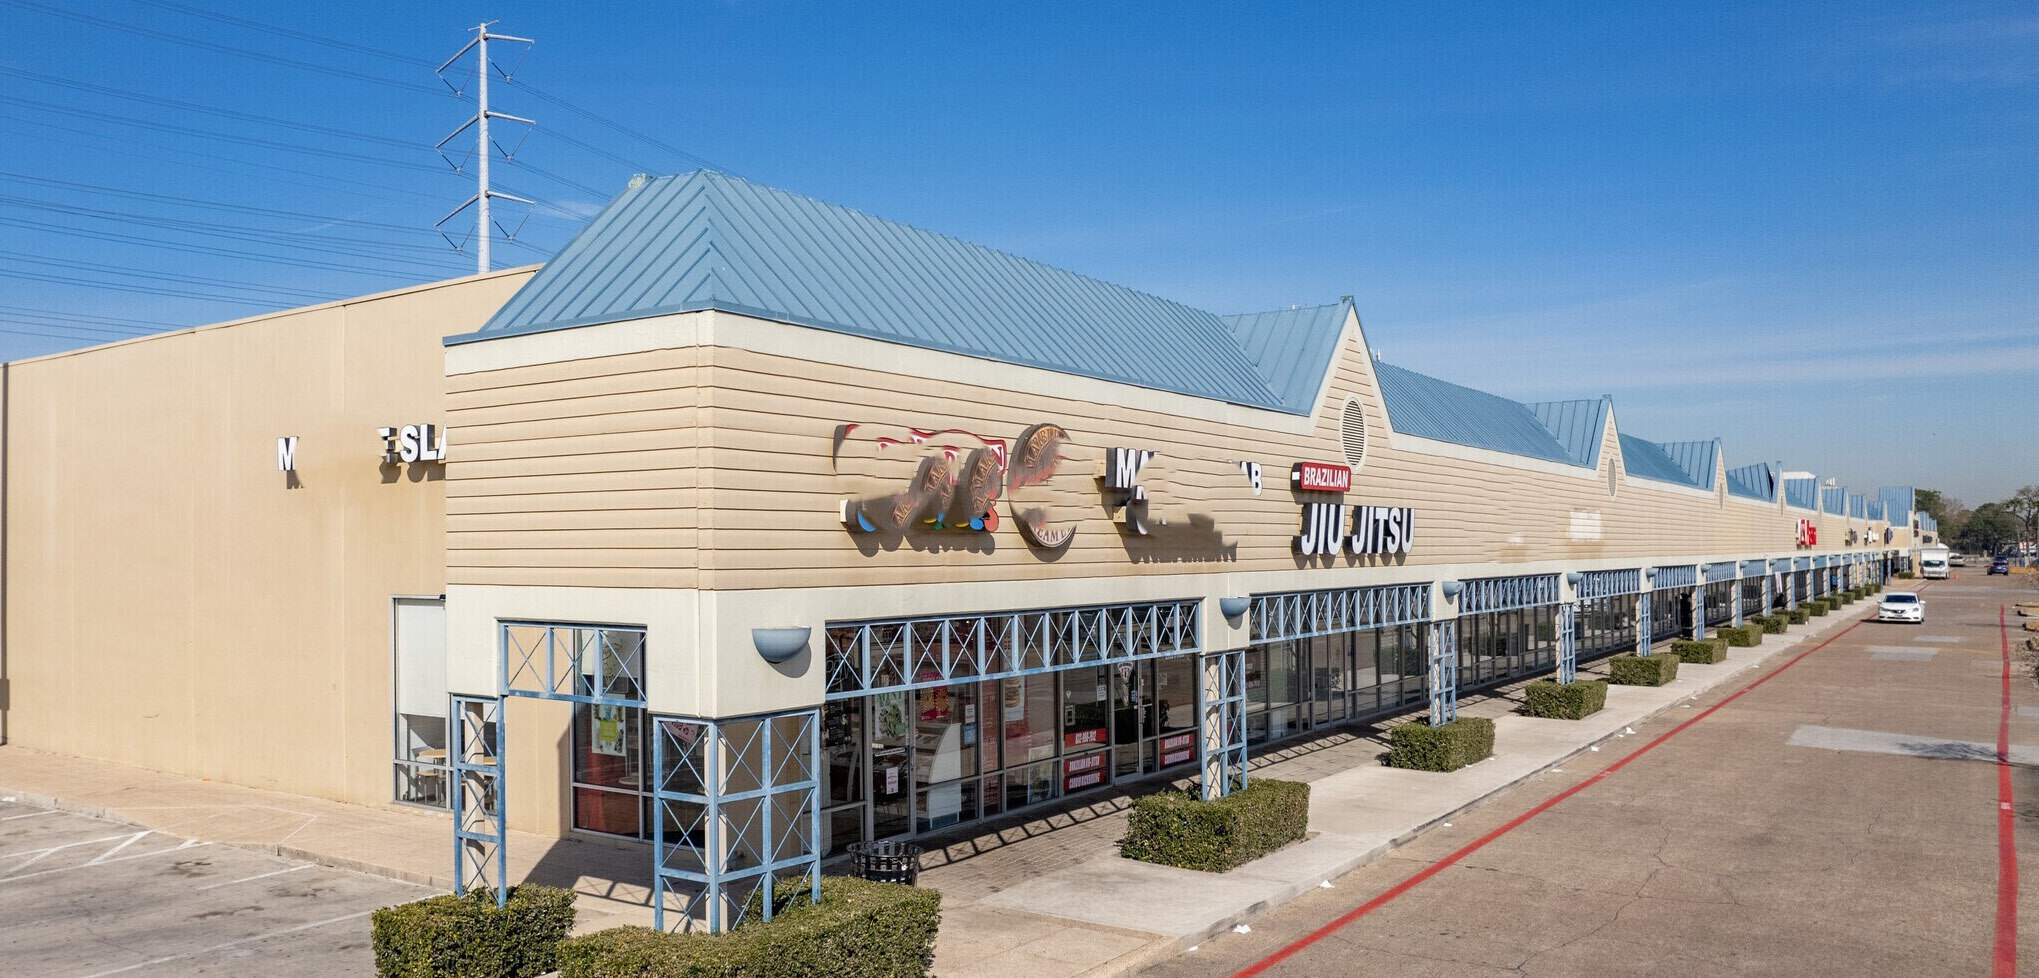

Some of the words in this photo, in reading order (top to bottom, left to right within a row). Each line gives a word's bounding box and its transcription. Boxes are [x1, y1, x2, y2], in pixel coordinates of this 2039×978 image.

[1303, 466, 1349, 488] BRAZILIAN
[1301, 503, 1345, 556] JIU
[1352, 506, 1415, 555] JITSU
